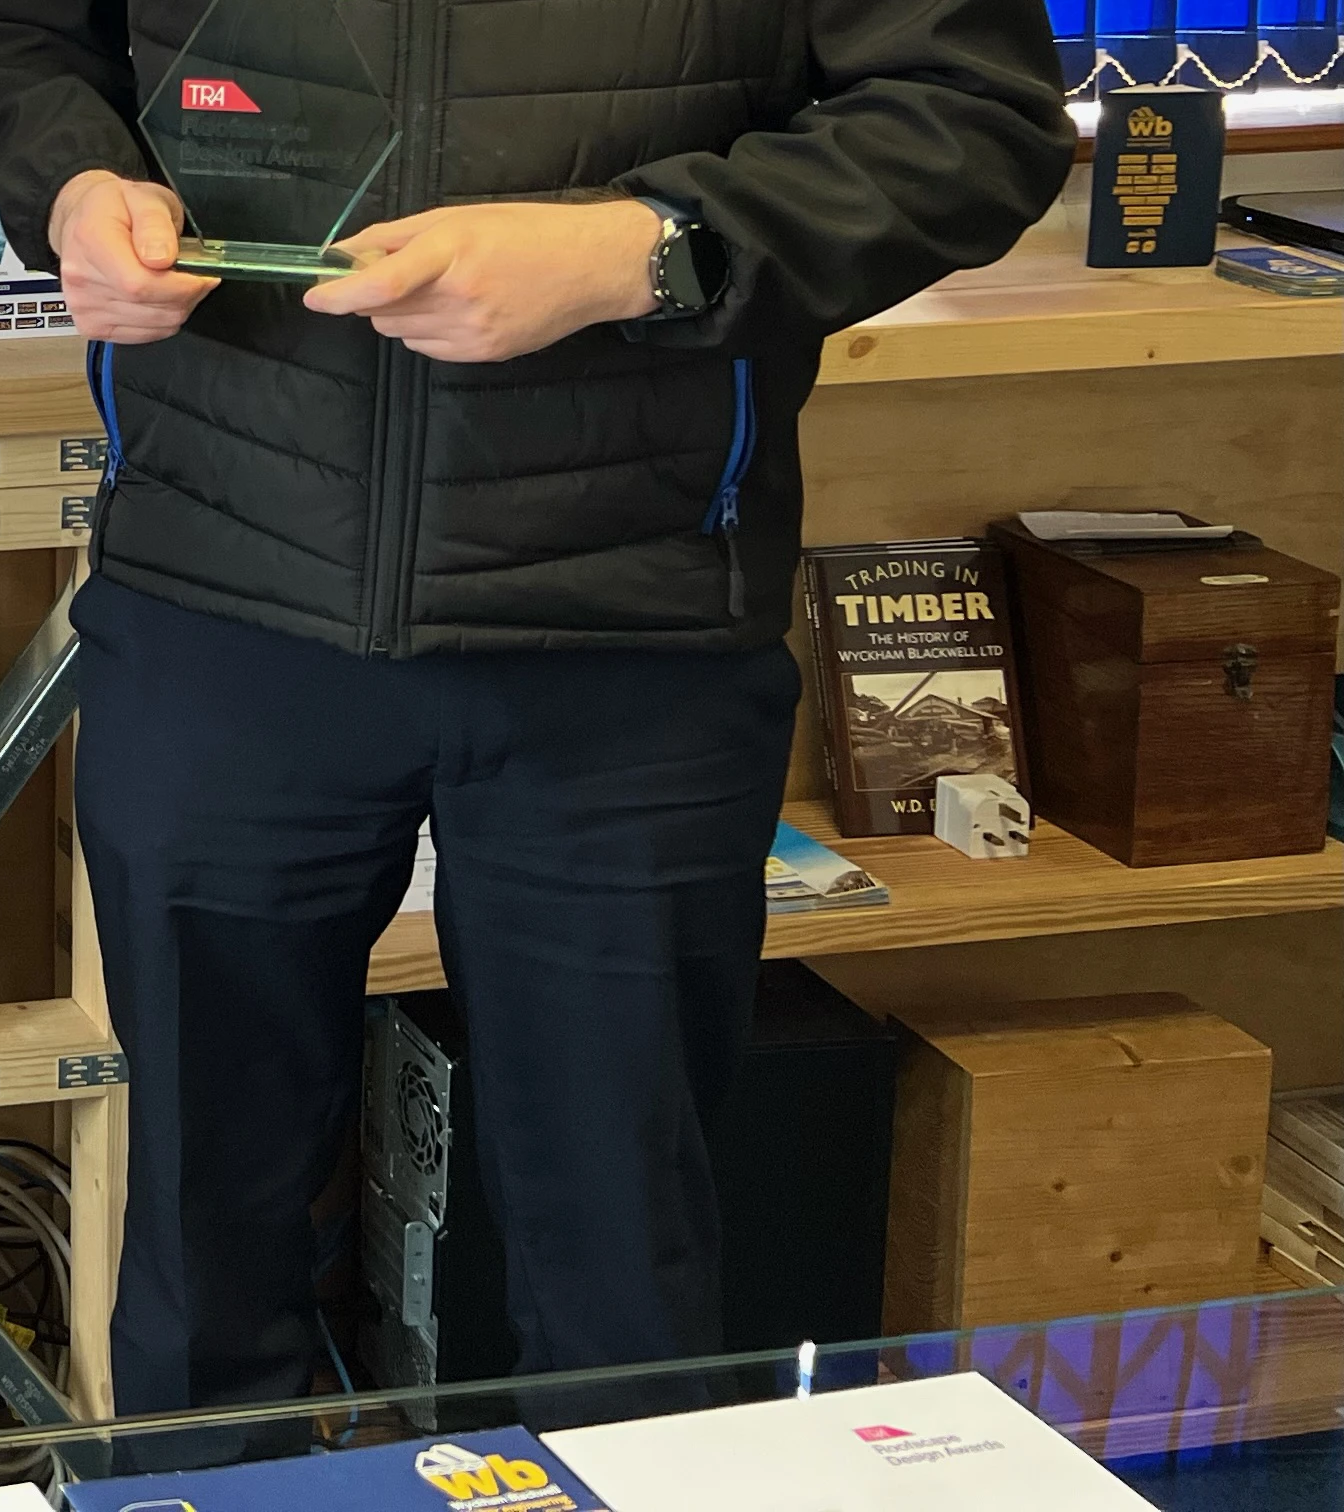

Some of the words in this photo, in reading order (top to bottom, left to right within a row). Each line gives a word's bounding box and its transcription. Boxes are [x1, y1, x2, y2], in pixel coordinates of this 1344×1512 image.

[188, 85, 226, 107] TRA
[1127, 116, 1173, 137] wb
[844, 560, 946, 591] TRADING
[955, 565, 979, 587] IN
[835, 592, 995, 627] TIMBER
[869, 632, 893, 645] THE
[897, 631, 949, 646] HISTORY
[953, 630, 970, 643] OF
[838, 648, 905, 663] WYCKHAM
[907, 646, 978, 661] BLACKWELL
[979, 645, 1003, 657] LTD
[891, 799, 926, 813] W.D.
[884, 1450, 945, 1467] Design
[427, 1453, 549, 1500] wb
